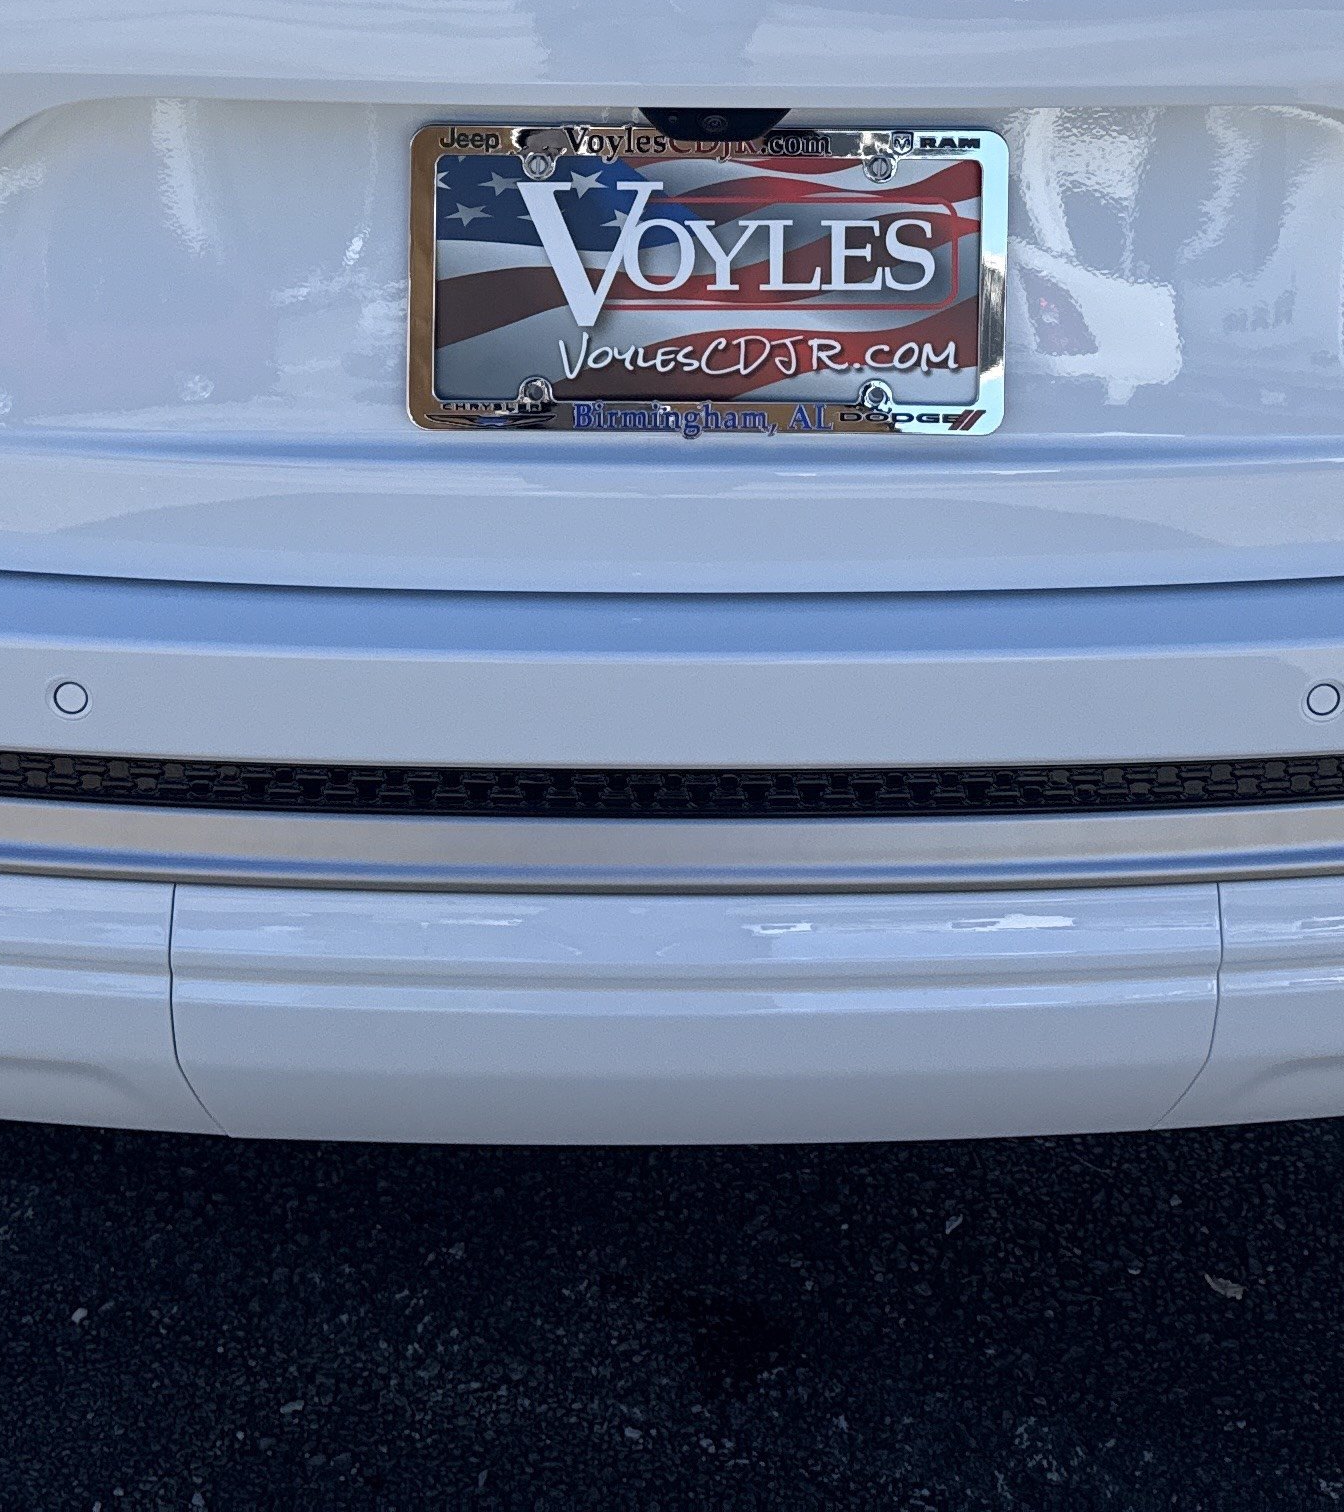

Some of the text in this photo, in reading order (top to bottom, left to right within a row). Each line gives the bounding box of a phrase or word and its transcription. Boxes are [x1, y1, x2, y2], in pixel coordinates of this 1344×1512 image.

[439, 126, 500, 153] Jeep
[919, 136, 981, 149] RAM
[517, 181, 937, 327] VOYLES
[573, 401, 835, 438] Birmingham, AL
[839, 412, 957, 424] DODGE
